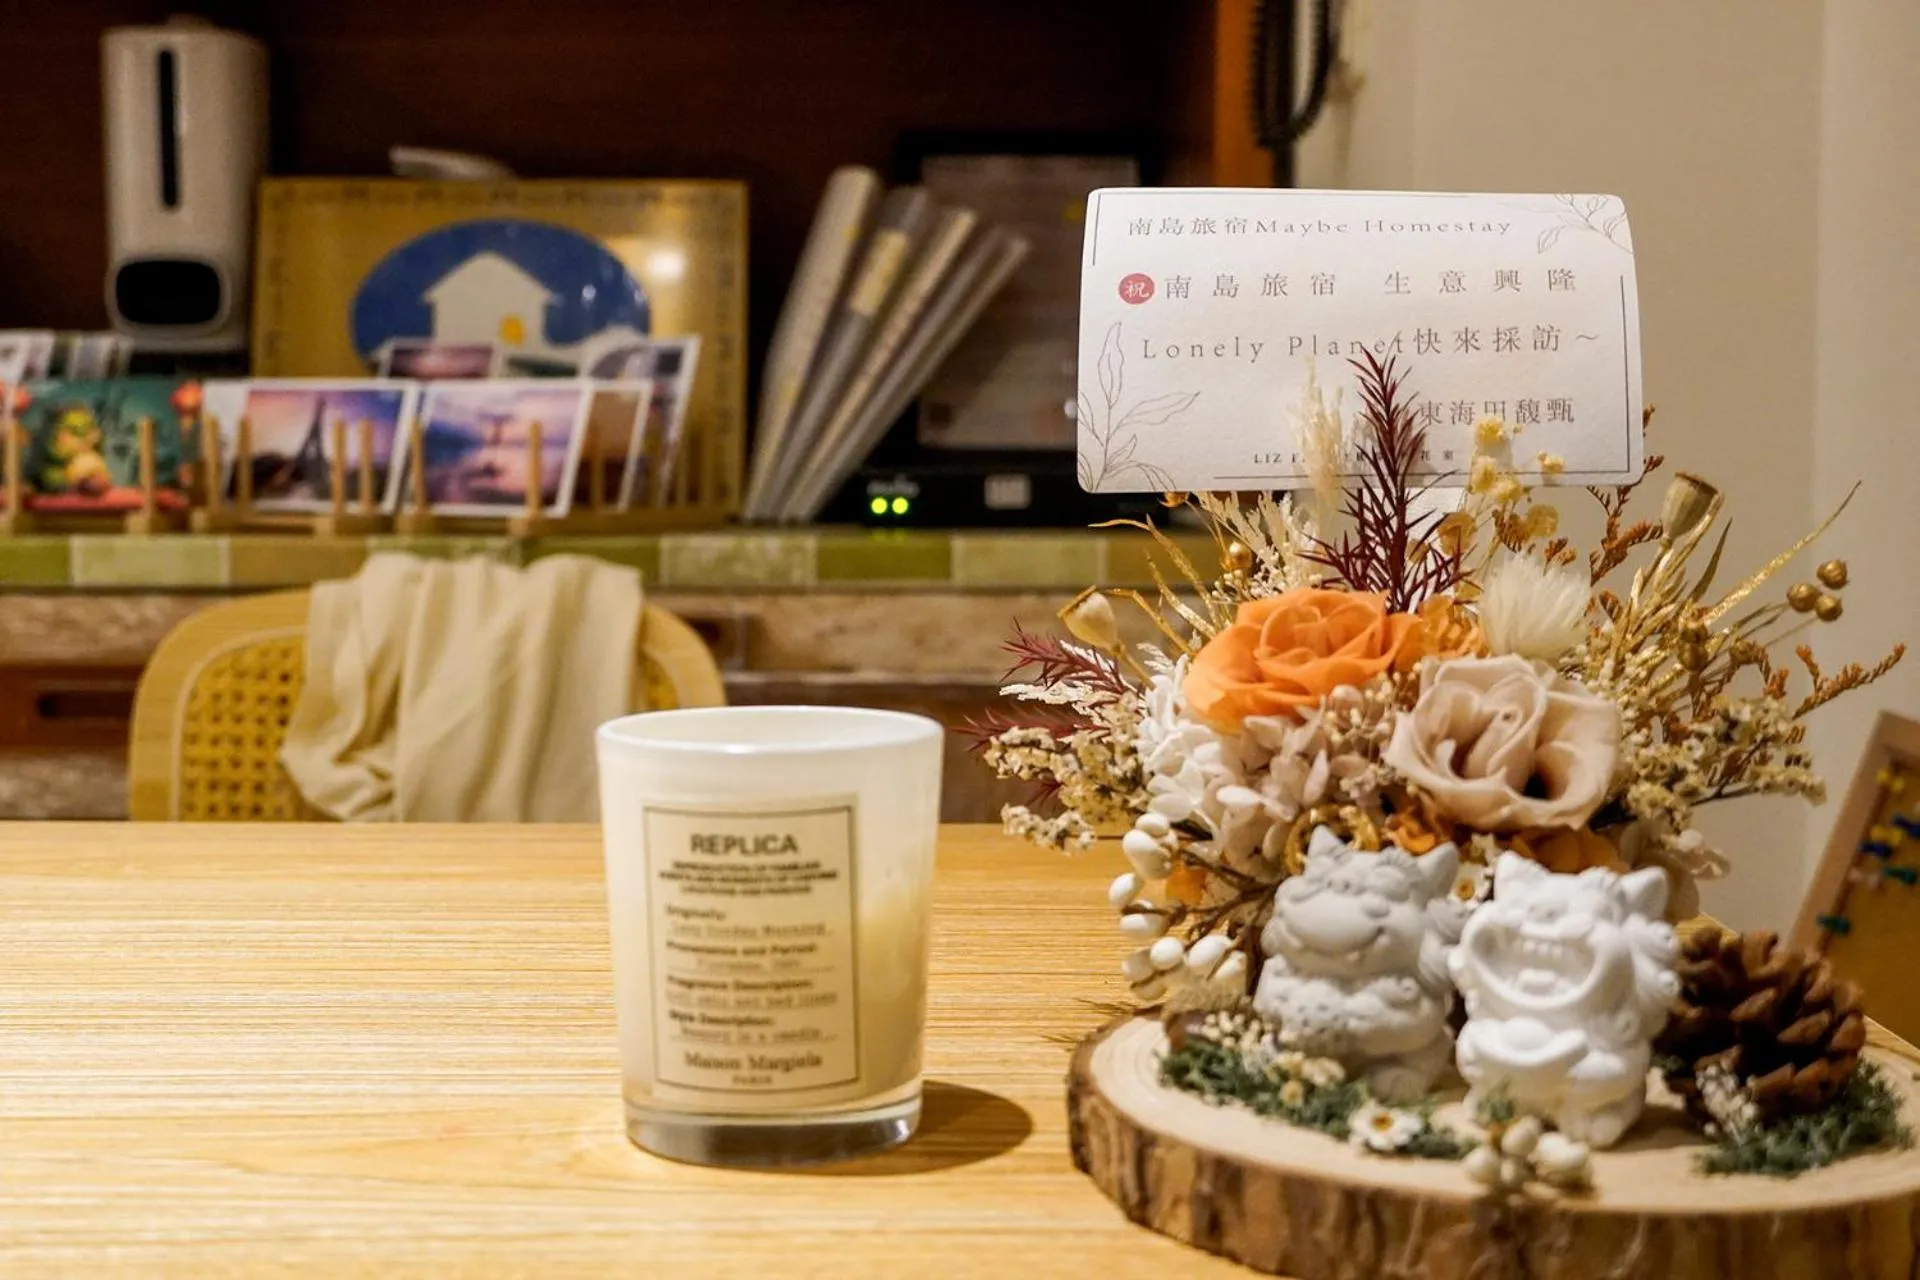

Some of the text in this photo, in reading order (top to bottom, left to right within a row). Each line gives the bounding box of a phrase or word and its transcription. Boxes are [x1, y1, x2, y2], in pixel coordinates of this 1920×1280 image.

[1364, 218, 1512, 235] Homestay
[1125, 278, 1150, 299] 祝
[1142, 336, 1265, 363] Lonely
[690, 833, 800, 857] REPLICA
